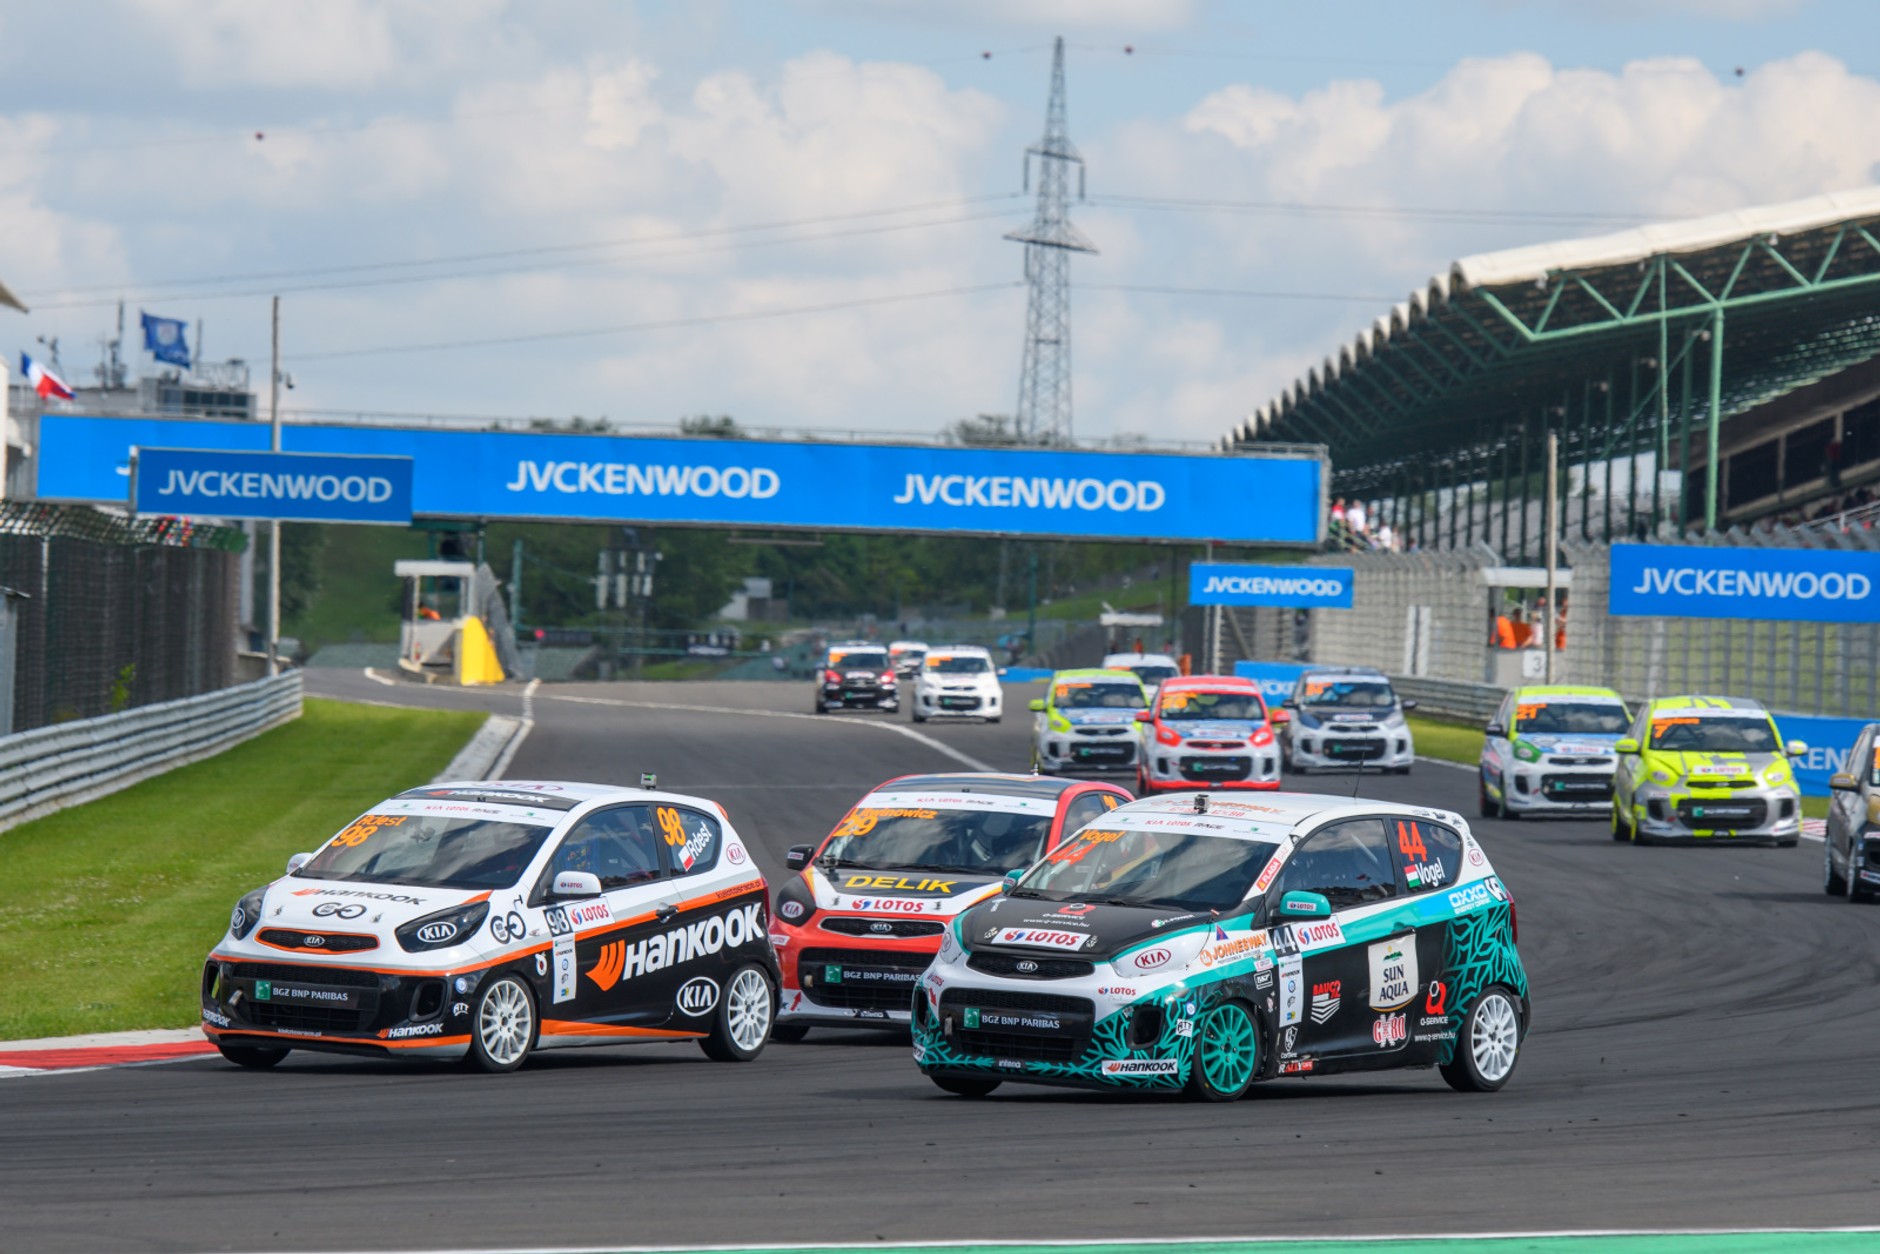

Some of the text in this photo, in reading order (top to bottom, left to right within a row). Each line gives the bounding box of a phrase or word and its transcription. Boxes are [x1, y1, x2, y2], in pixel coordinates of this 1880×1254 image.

[158, 469, 393, 504] JVCKENWOOD
[507, 460, 781, 499] JVCKENWOOD
[894, 474, 1166, 512] JVCKENWOOD
[1203, 575, 1343, 598] JVCKENWOOD
[1633, 567, 1871, 600] JVCKENWOOD
[1532, 656, 1542, 673] 3
[331, 825, 379, 848] 98
[657, 807, 686, 847] 98
[832, 815, 878, 837] 29
[1079, 829, 1127, 845] Vogel
[686, 821, 713, 861] Rdest
[1397, 821, 1428, 862] 44
[1047, 841, 1098, 866] 44
[1415, 857, 1446, 888] Vogel
[845, 875, 958, 894] DELIK
[1448, 883, 1488, 908] OXXO
[581, 904, 609, 922] LOTOS
[873, 899, 924, 912] LOTOS
[546, 909, 570, 934] 98
[1309, 922, 1339, 942] LOTOS
[1025, 930, 1080, 946] LOTOS
[1212, 933, 1267, 960] JONNESWAY
[1273, 927, 1297, 954] 44
[1140, 951, 1167, 966] KIA
[844, 970, 921, 982] BGZ BNP PARIBAS
[1383, 964, 1404, 983] SUN
[272, 987, 348, 1001] BGZ BNP PARIBAS
[684, 985, 713, 1008] KIA
[1110, 987, 1136, 995] LOTOS
[1379, 981, 1409, 1002] AQUA
[982, 1014, 1060, 1029] BGZ BNP PARIBAS
[1420, 1016, 1448, 1026] Q-SERVICE
